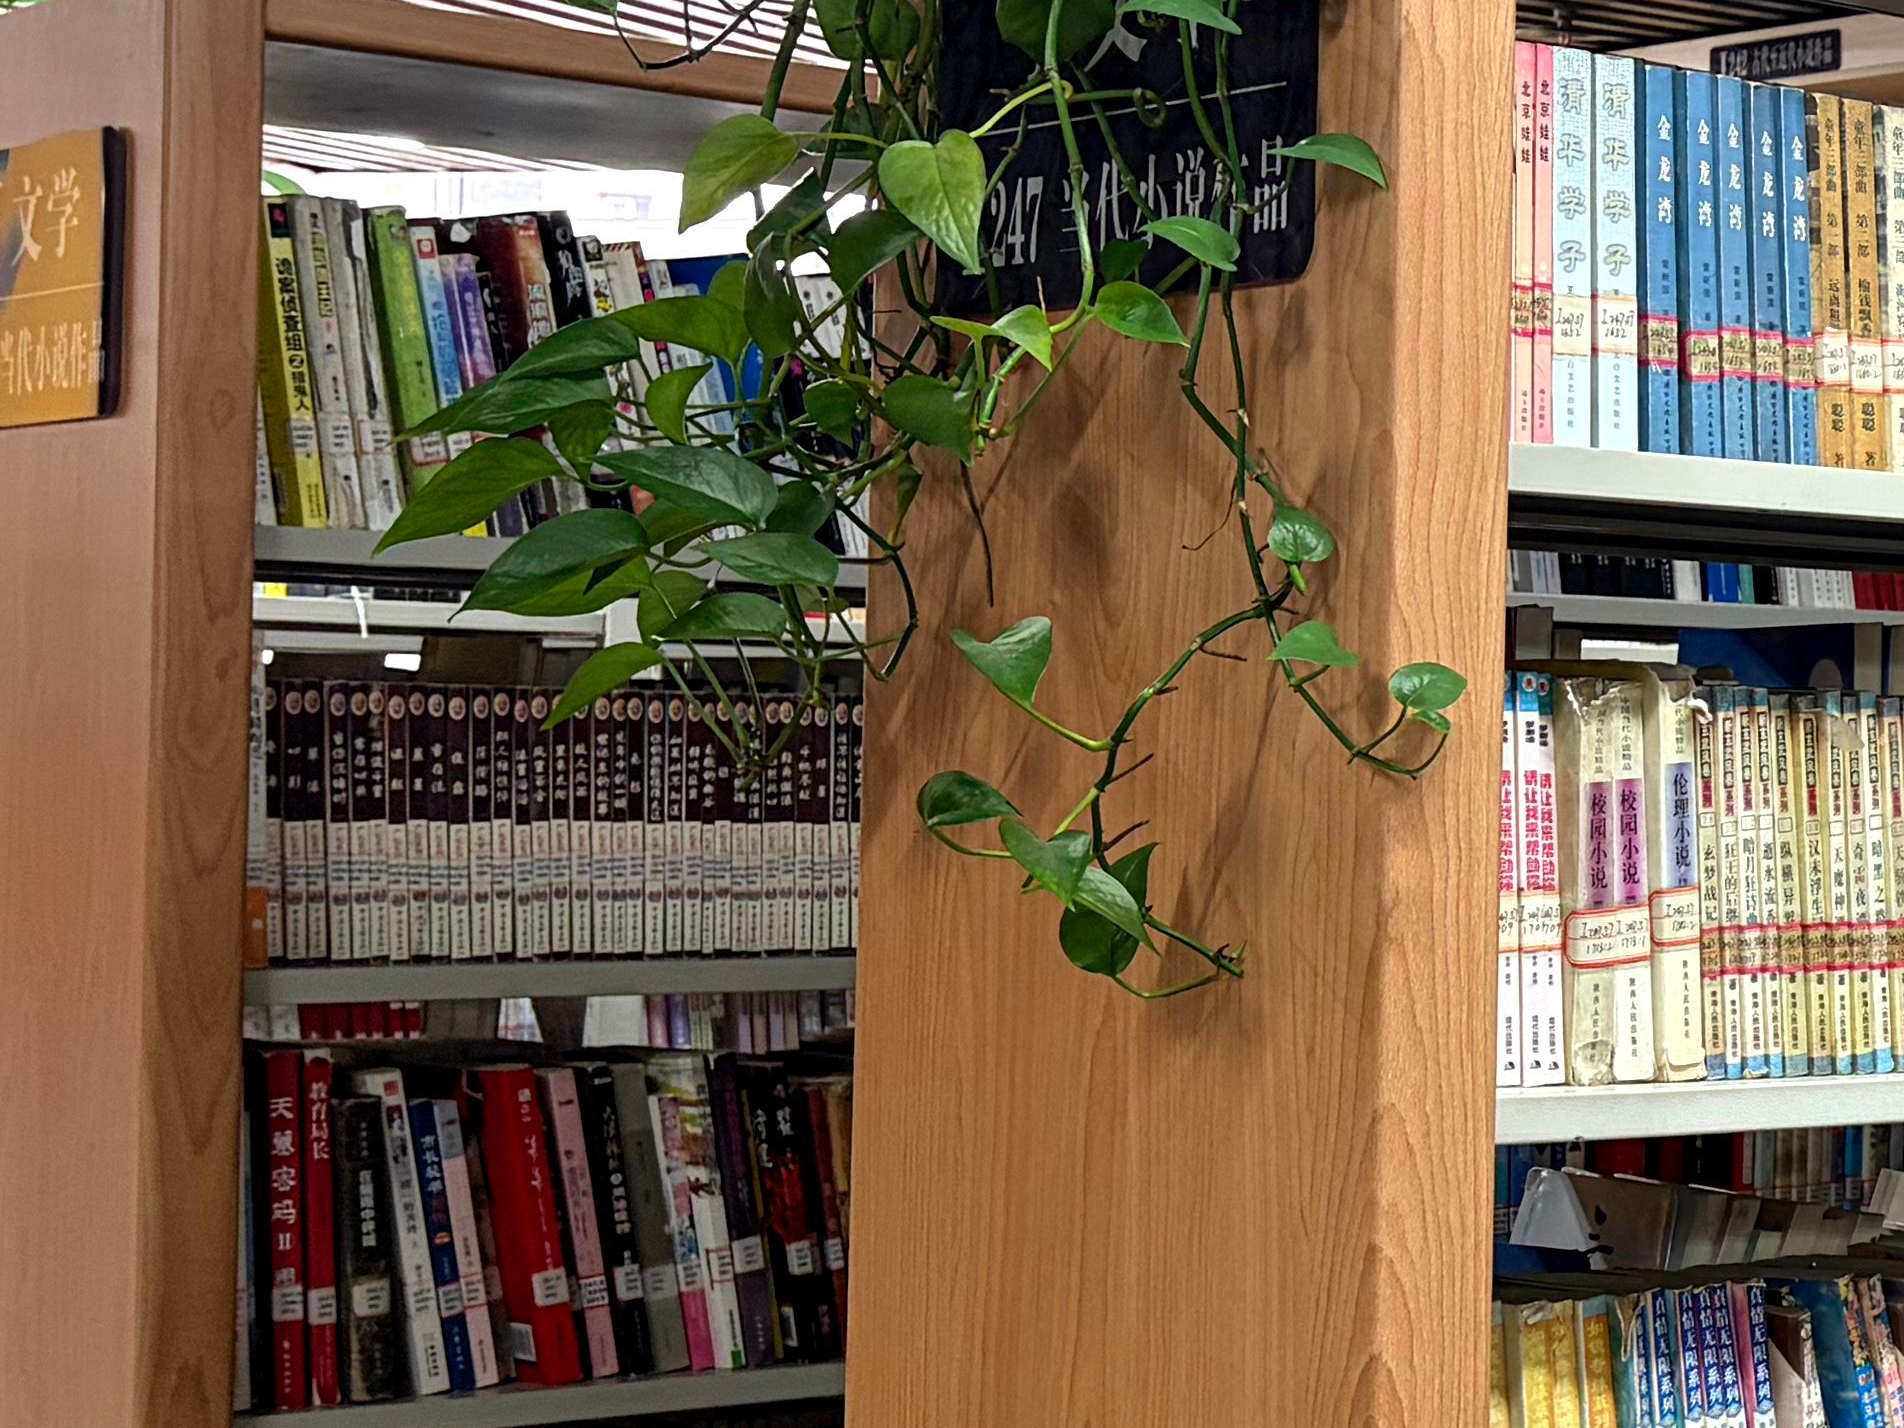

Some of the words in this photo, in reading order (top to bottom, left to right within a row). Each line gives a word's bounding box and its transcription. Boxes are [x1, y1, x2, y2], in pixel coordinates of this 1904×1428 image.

[1556, 76, 1587, 273] 清华学子
[1602, 82, 1633, 277] 清华学子
[962, 176, 1044, 276] 247
[1589, 791, 1609, 890] 校园小说
[1620, 788, 1641, 885] 校园小说
[1673, 772, 1692, 868] 伦理小说
